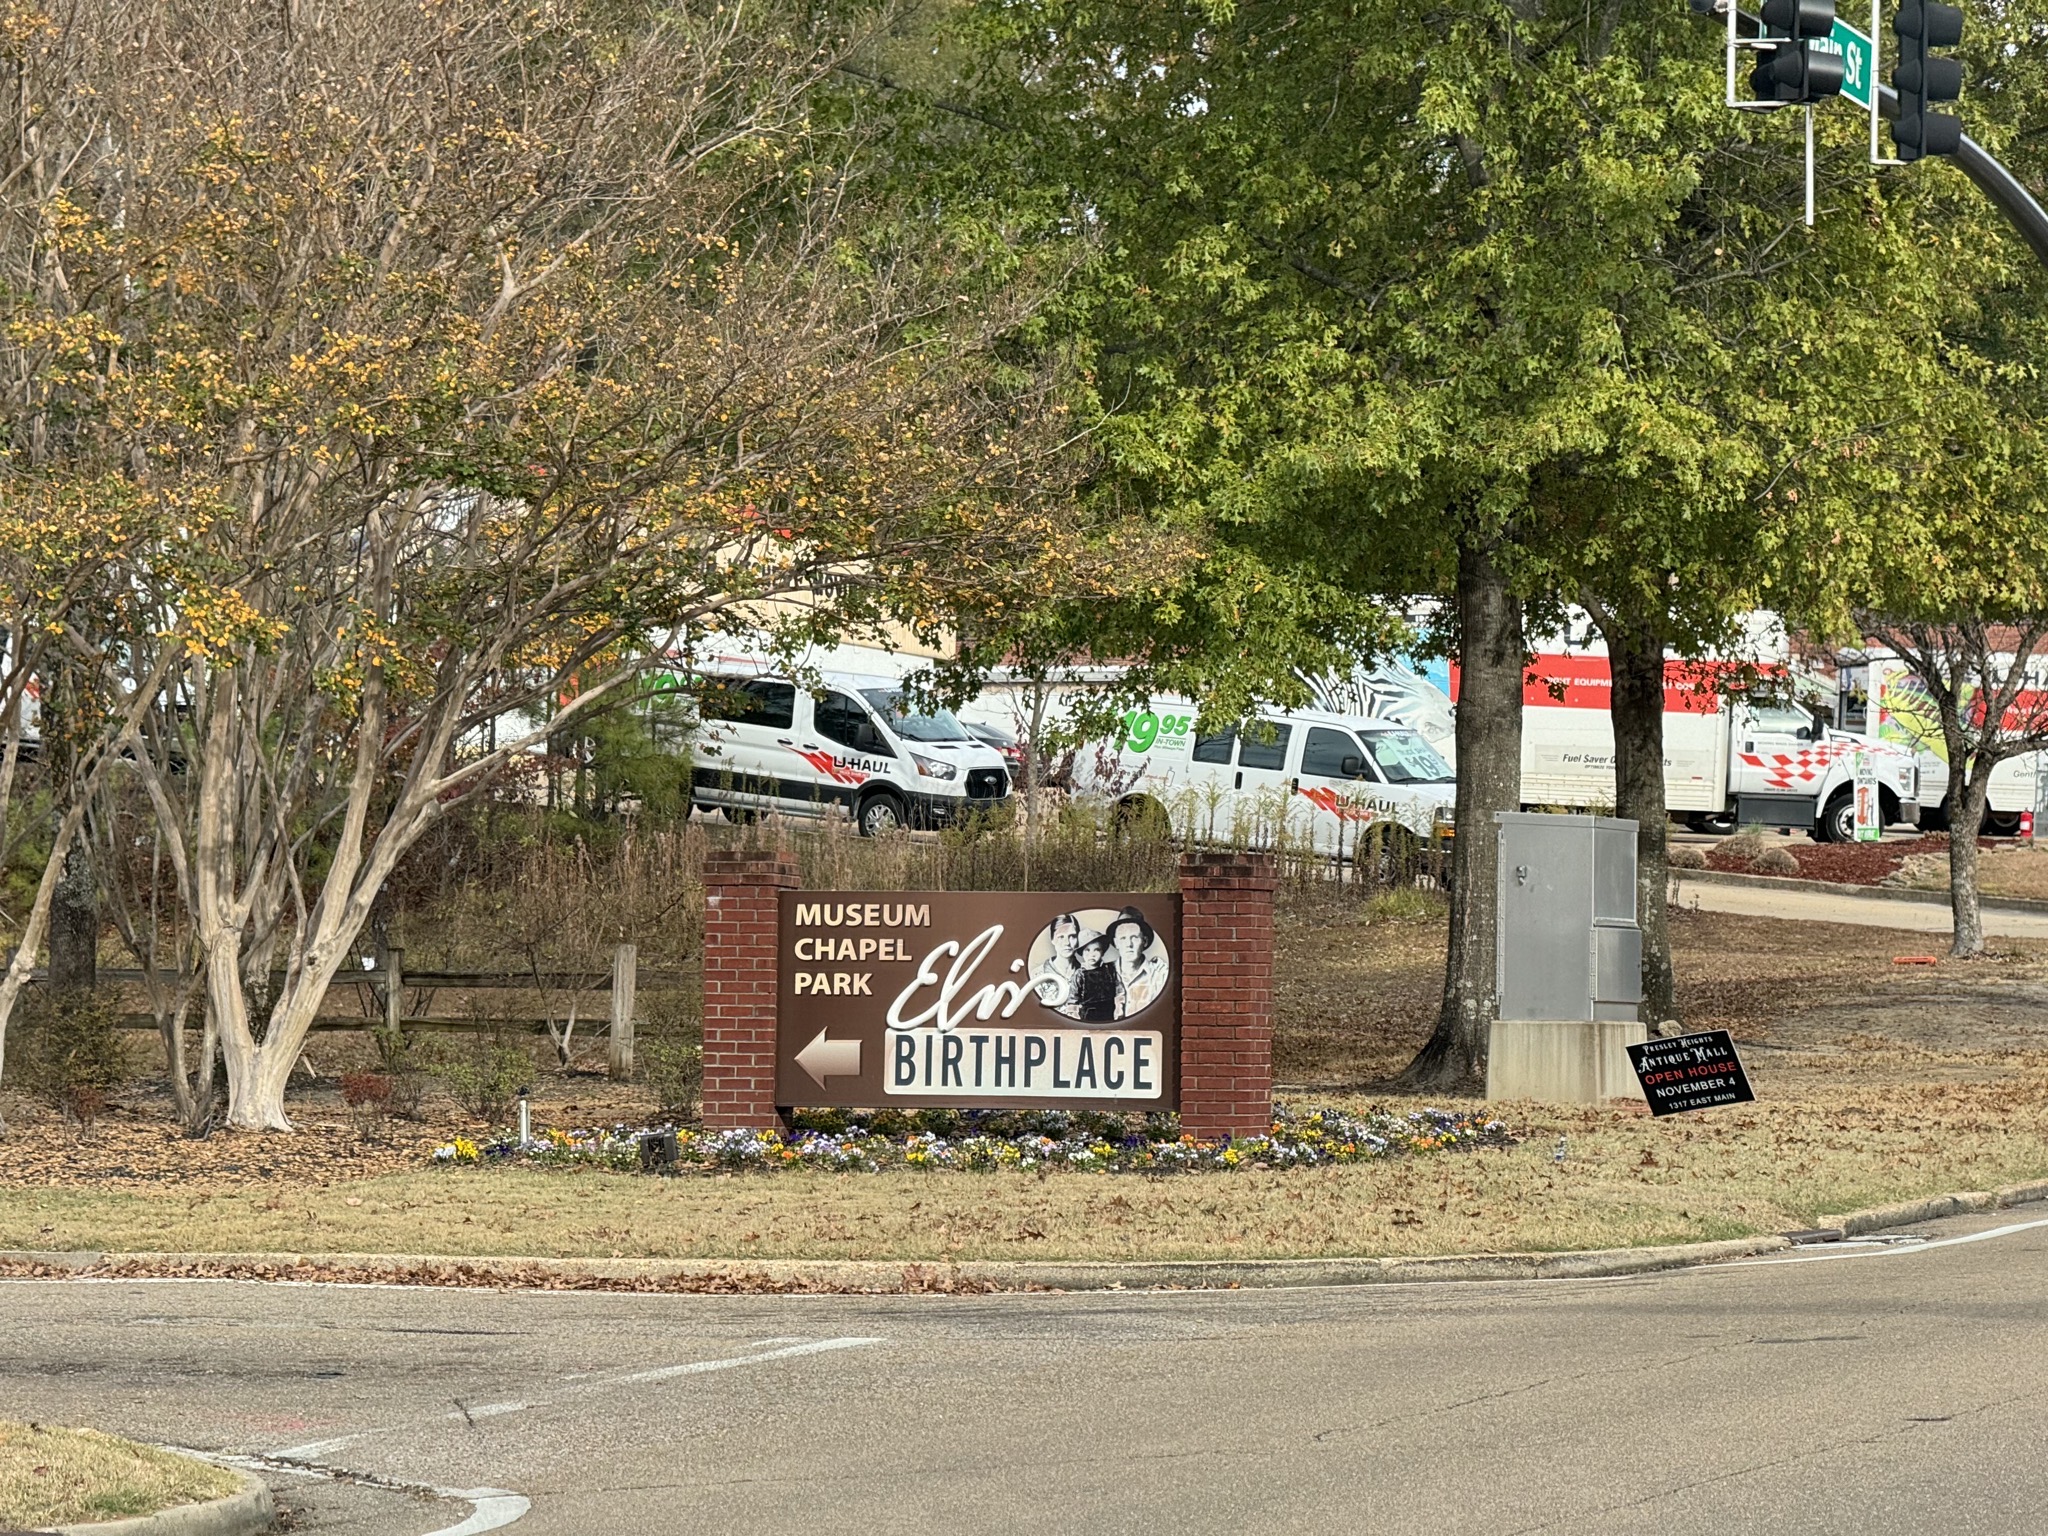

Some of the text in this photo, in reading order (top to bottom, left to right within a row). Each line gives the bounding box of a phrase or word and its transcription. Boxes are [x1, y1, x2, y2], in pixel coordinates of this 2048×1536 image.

[1845, 40, 1863, 90] St
[1155, 738, 1187, 748] IN-TOWN
[833, 755, 892, 775] U-HAUL
[1562, 753, 1583, 763] Fuel
[1335, 795, 1401, 815] U-HAUL
[795, 904, 931, 926] MUSEUM
[794, 938, 913, 961] CHAPEL
[794, 973, 873, 995] PARK
[885, 924, 1070, 1033] Elvis
[894, 1034, 1154, 1091] BIRTHPLACE
[1638, 1046, 1728, 1074] ANTIQUE MALL
[1644, 1061, 1737, 1085] OPEN HOUSE
[1656, 1076, 1736, 1099] NOVEMBER 4
[1668, 1092, 1736, 1110] 1317 EAST MAIN
